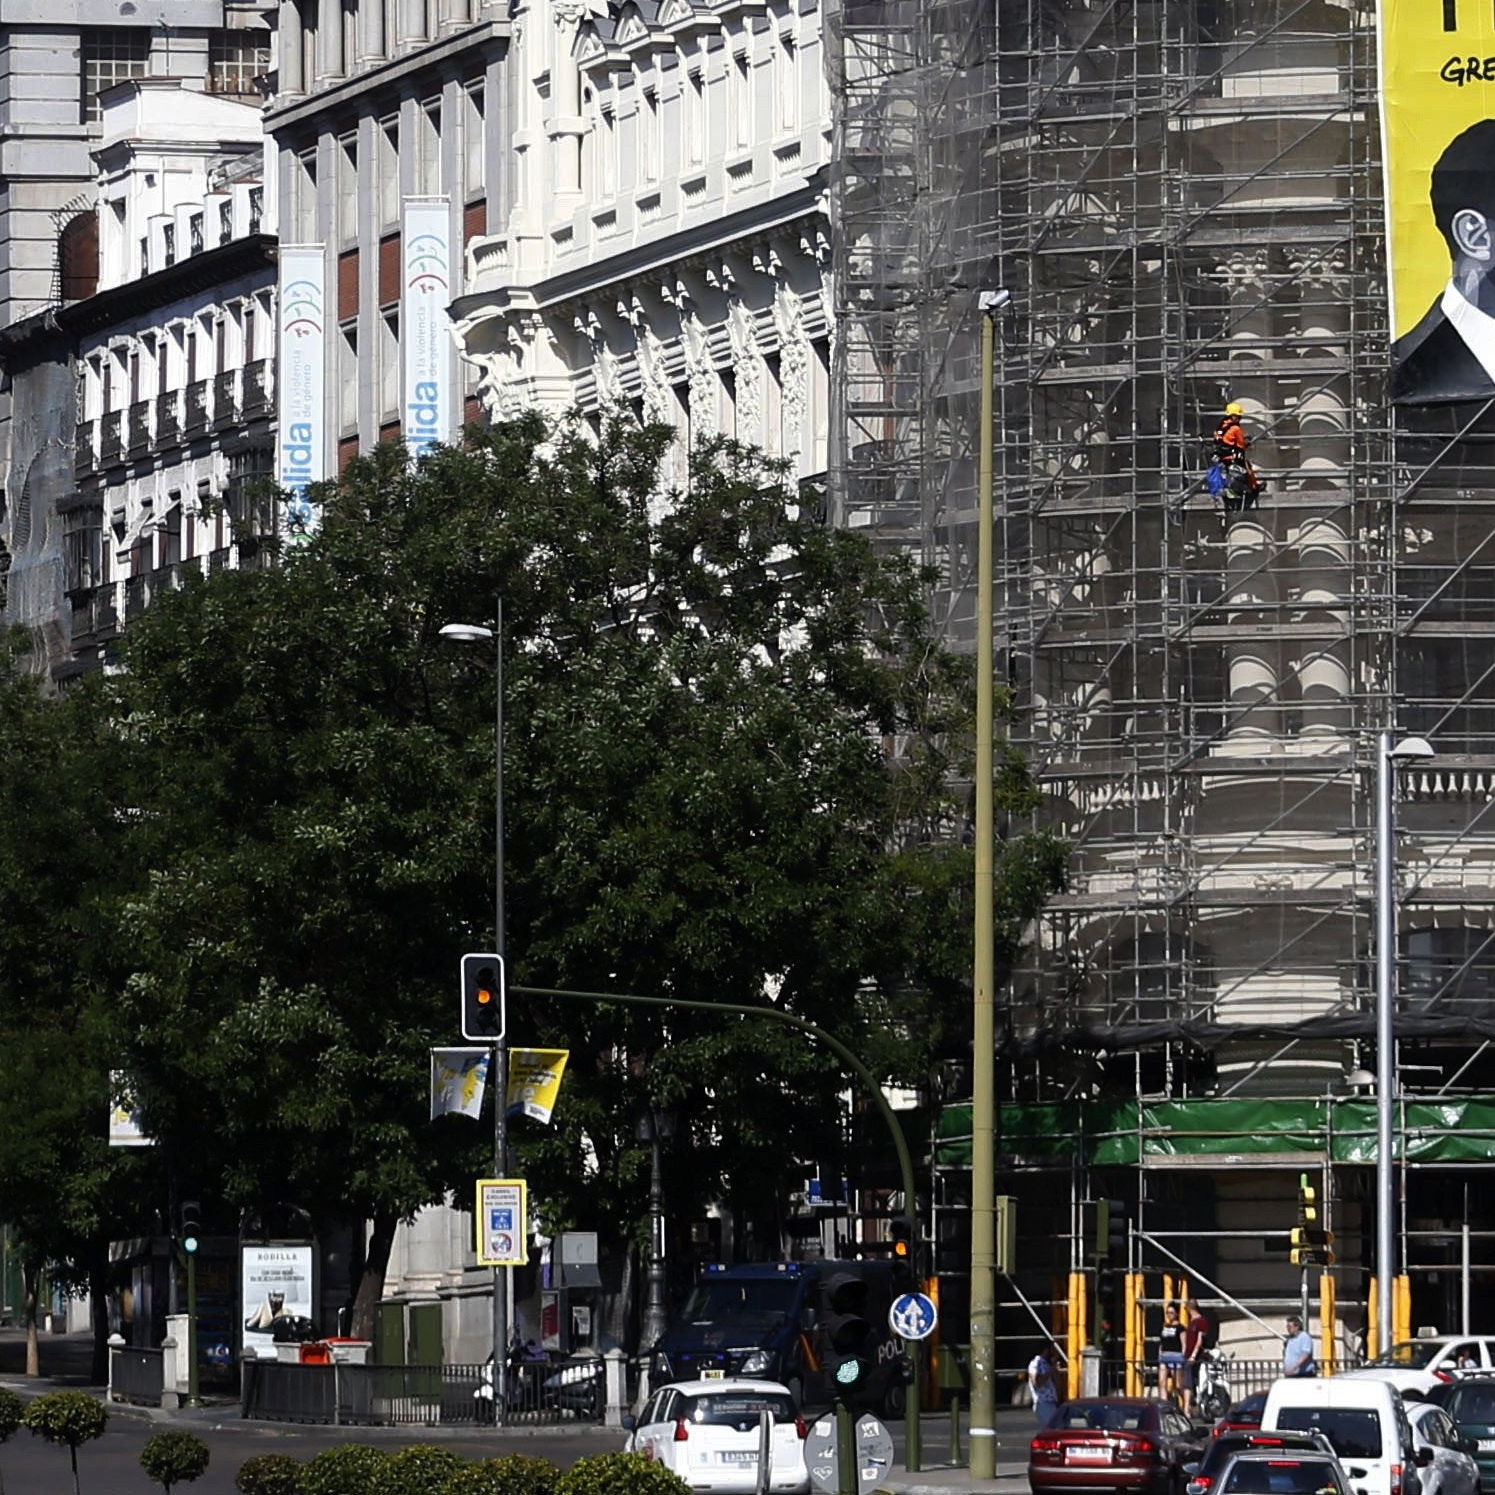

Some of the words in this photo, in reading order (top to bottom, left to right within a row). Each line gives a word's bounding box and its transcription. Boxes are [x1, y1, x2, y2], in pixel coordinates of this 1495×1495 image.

[416, 306, 426, 354] violencia
[291, 349, 301, 396] violencia
[428, 362, 438, 375] de
[408, 381, 439, 462] alida
